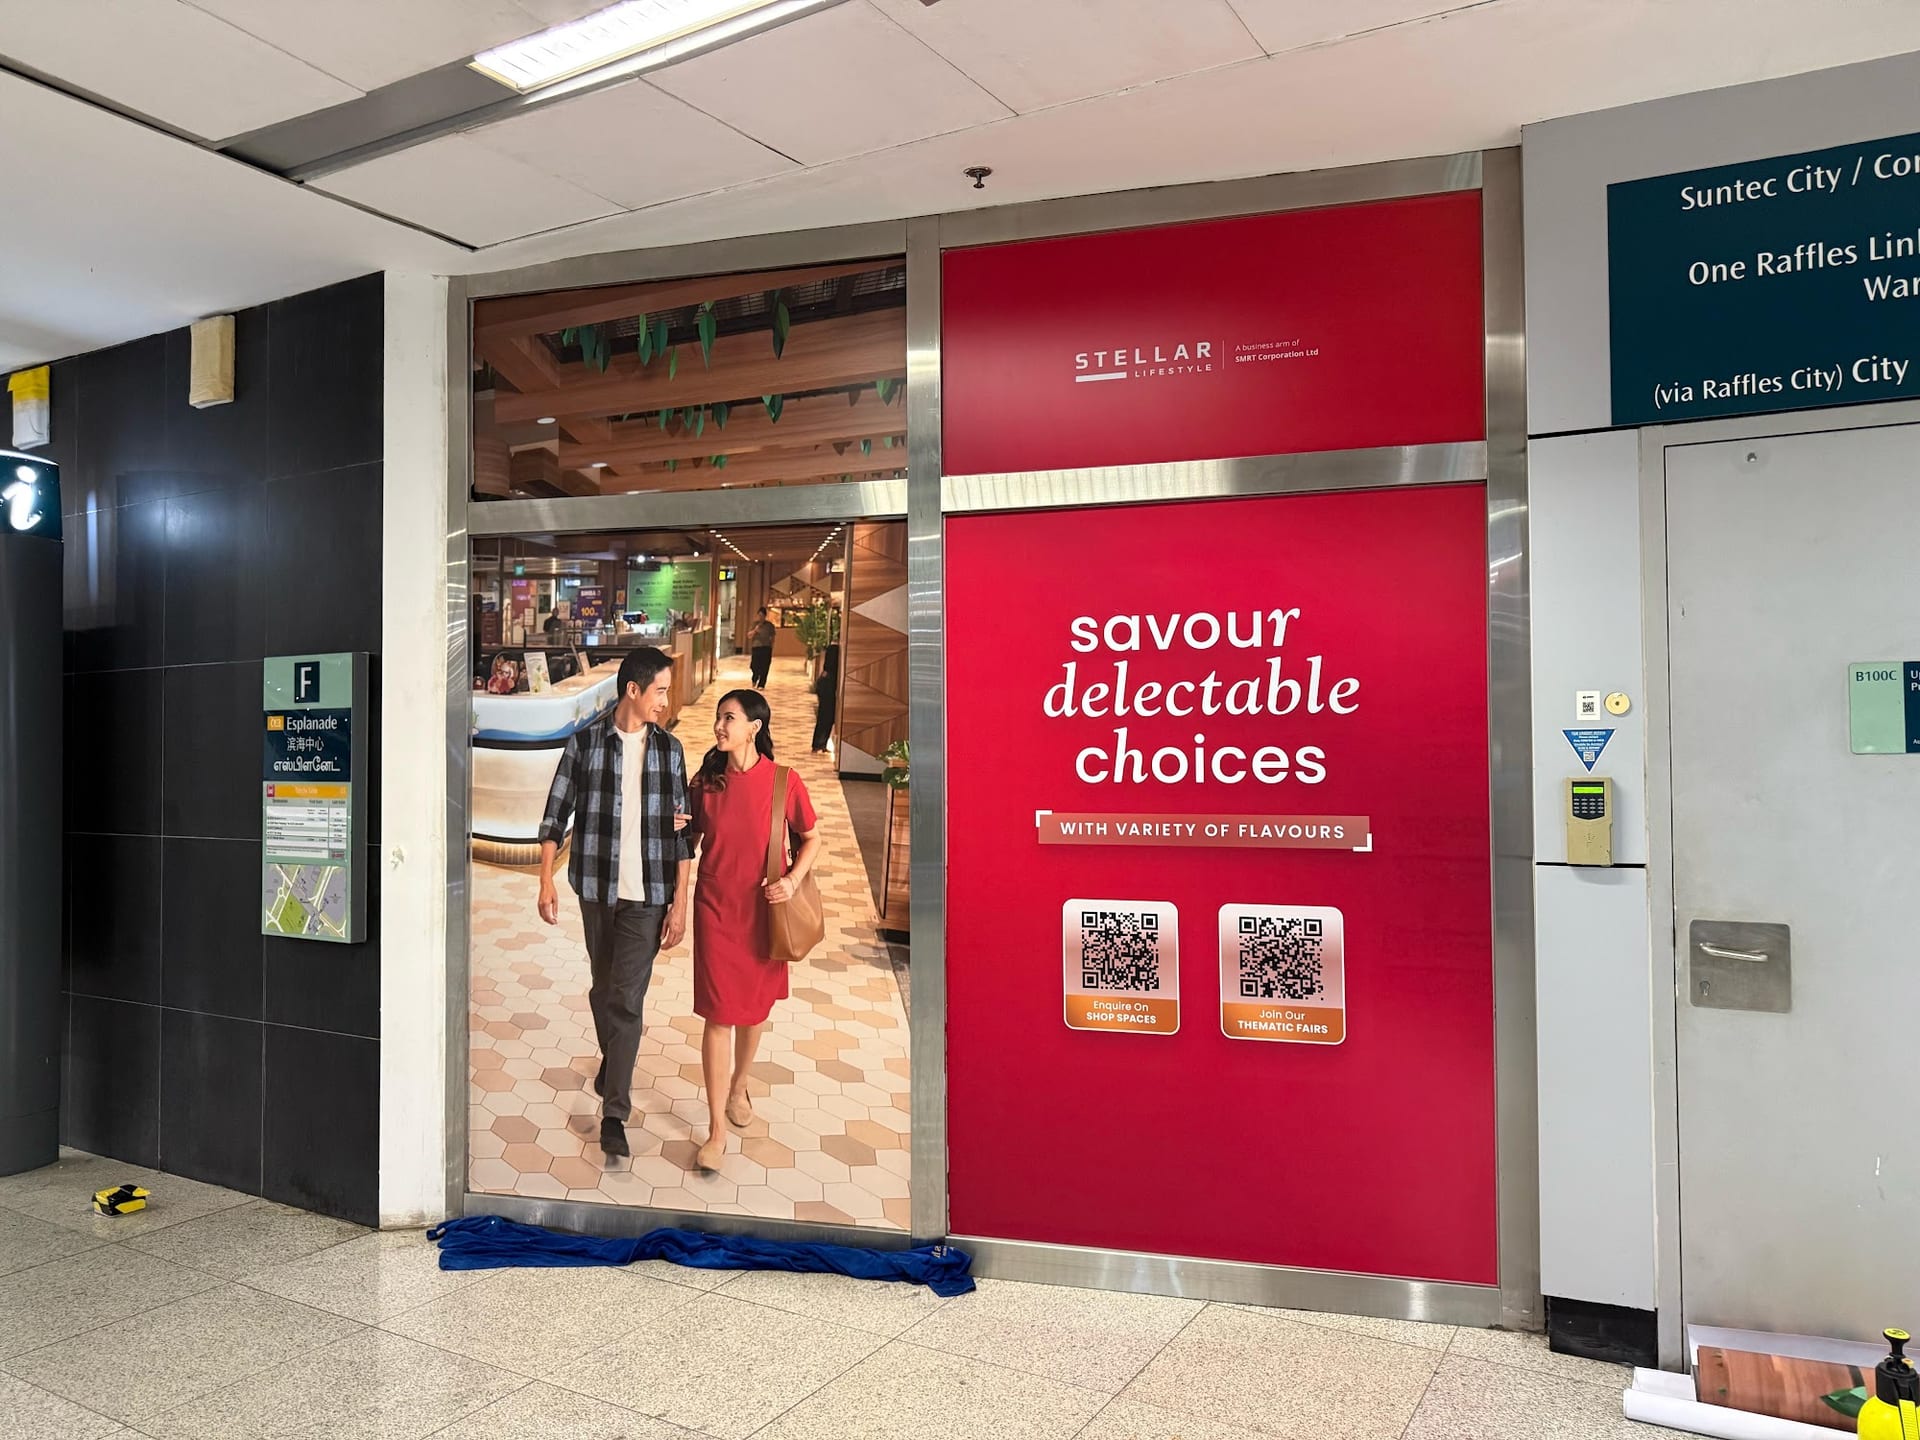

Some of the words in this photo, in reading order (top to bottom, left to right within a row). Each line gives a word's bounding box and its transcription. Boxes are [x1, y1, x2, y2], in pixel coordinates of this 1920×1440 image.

[1680, 177, 1777, 210] Suntec
[1787, 165, 1842, 193] City
[1851, 156, 1863, 186] /
[1689, 260, 1746, 285] One
[1757, 242, 1858, 276] Raffles
[1242, 342, 1274, 351] business
[1291, 339, 1300, 347] of
[1075, 341, 1212, 370] STELLAR
[1235, 354, 1257, 363] SMRT
[1258, 350, 1304, 361] Corporation
[1305, 348, 1319, 357] Ltd
[1134, 363, 1212, 378] LIFESTYLE
[1654, 382, 1693, 409] (via
[1703, 373, 1783, 400] Raffles
[1790, 363, 1843, 391] City)
[1852, 355, 1909, 385] City
[1070, 607, 1300, 653] savour
[301, 666, 312, 698] F
[1856, 670, 1897, 682] B100C
[1043, 655, 1361, 718] delectable
[286, 715, 338, 733] Esplanade
[287, 736, 325, 752] 滨海中心
[1075, 727, 1327, 784] choices
[1060, 822, 1108, 836] WITH
[1116, 823, 1197, 837] VARIETY
[1204, 824, 1230, 838] OF
[1239, 825, 1345, 839] FLAVOURS
[1093, 1001, 1132, 1012] Enquire
[1134, 1002, 1149, 1013] On
[1259, 1010, 1283, 1020] Join
[1285, 1010, 1306, 1021] Our
[1086, 1011, 1115, 1022] SHOP
[1117, 1013, 1157, 1024] SPACES
[1237, 1020, 1294, 1032] THEMATIC
[1296, 1023, 1329, 1034] FAIRS
